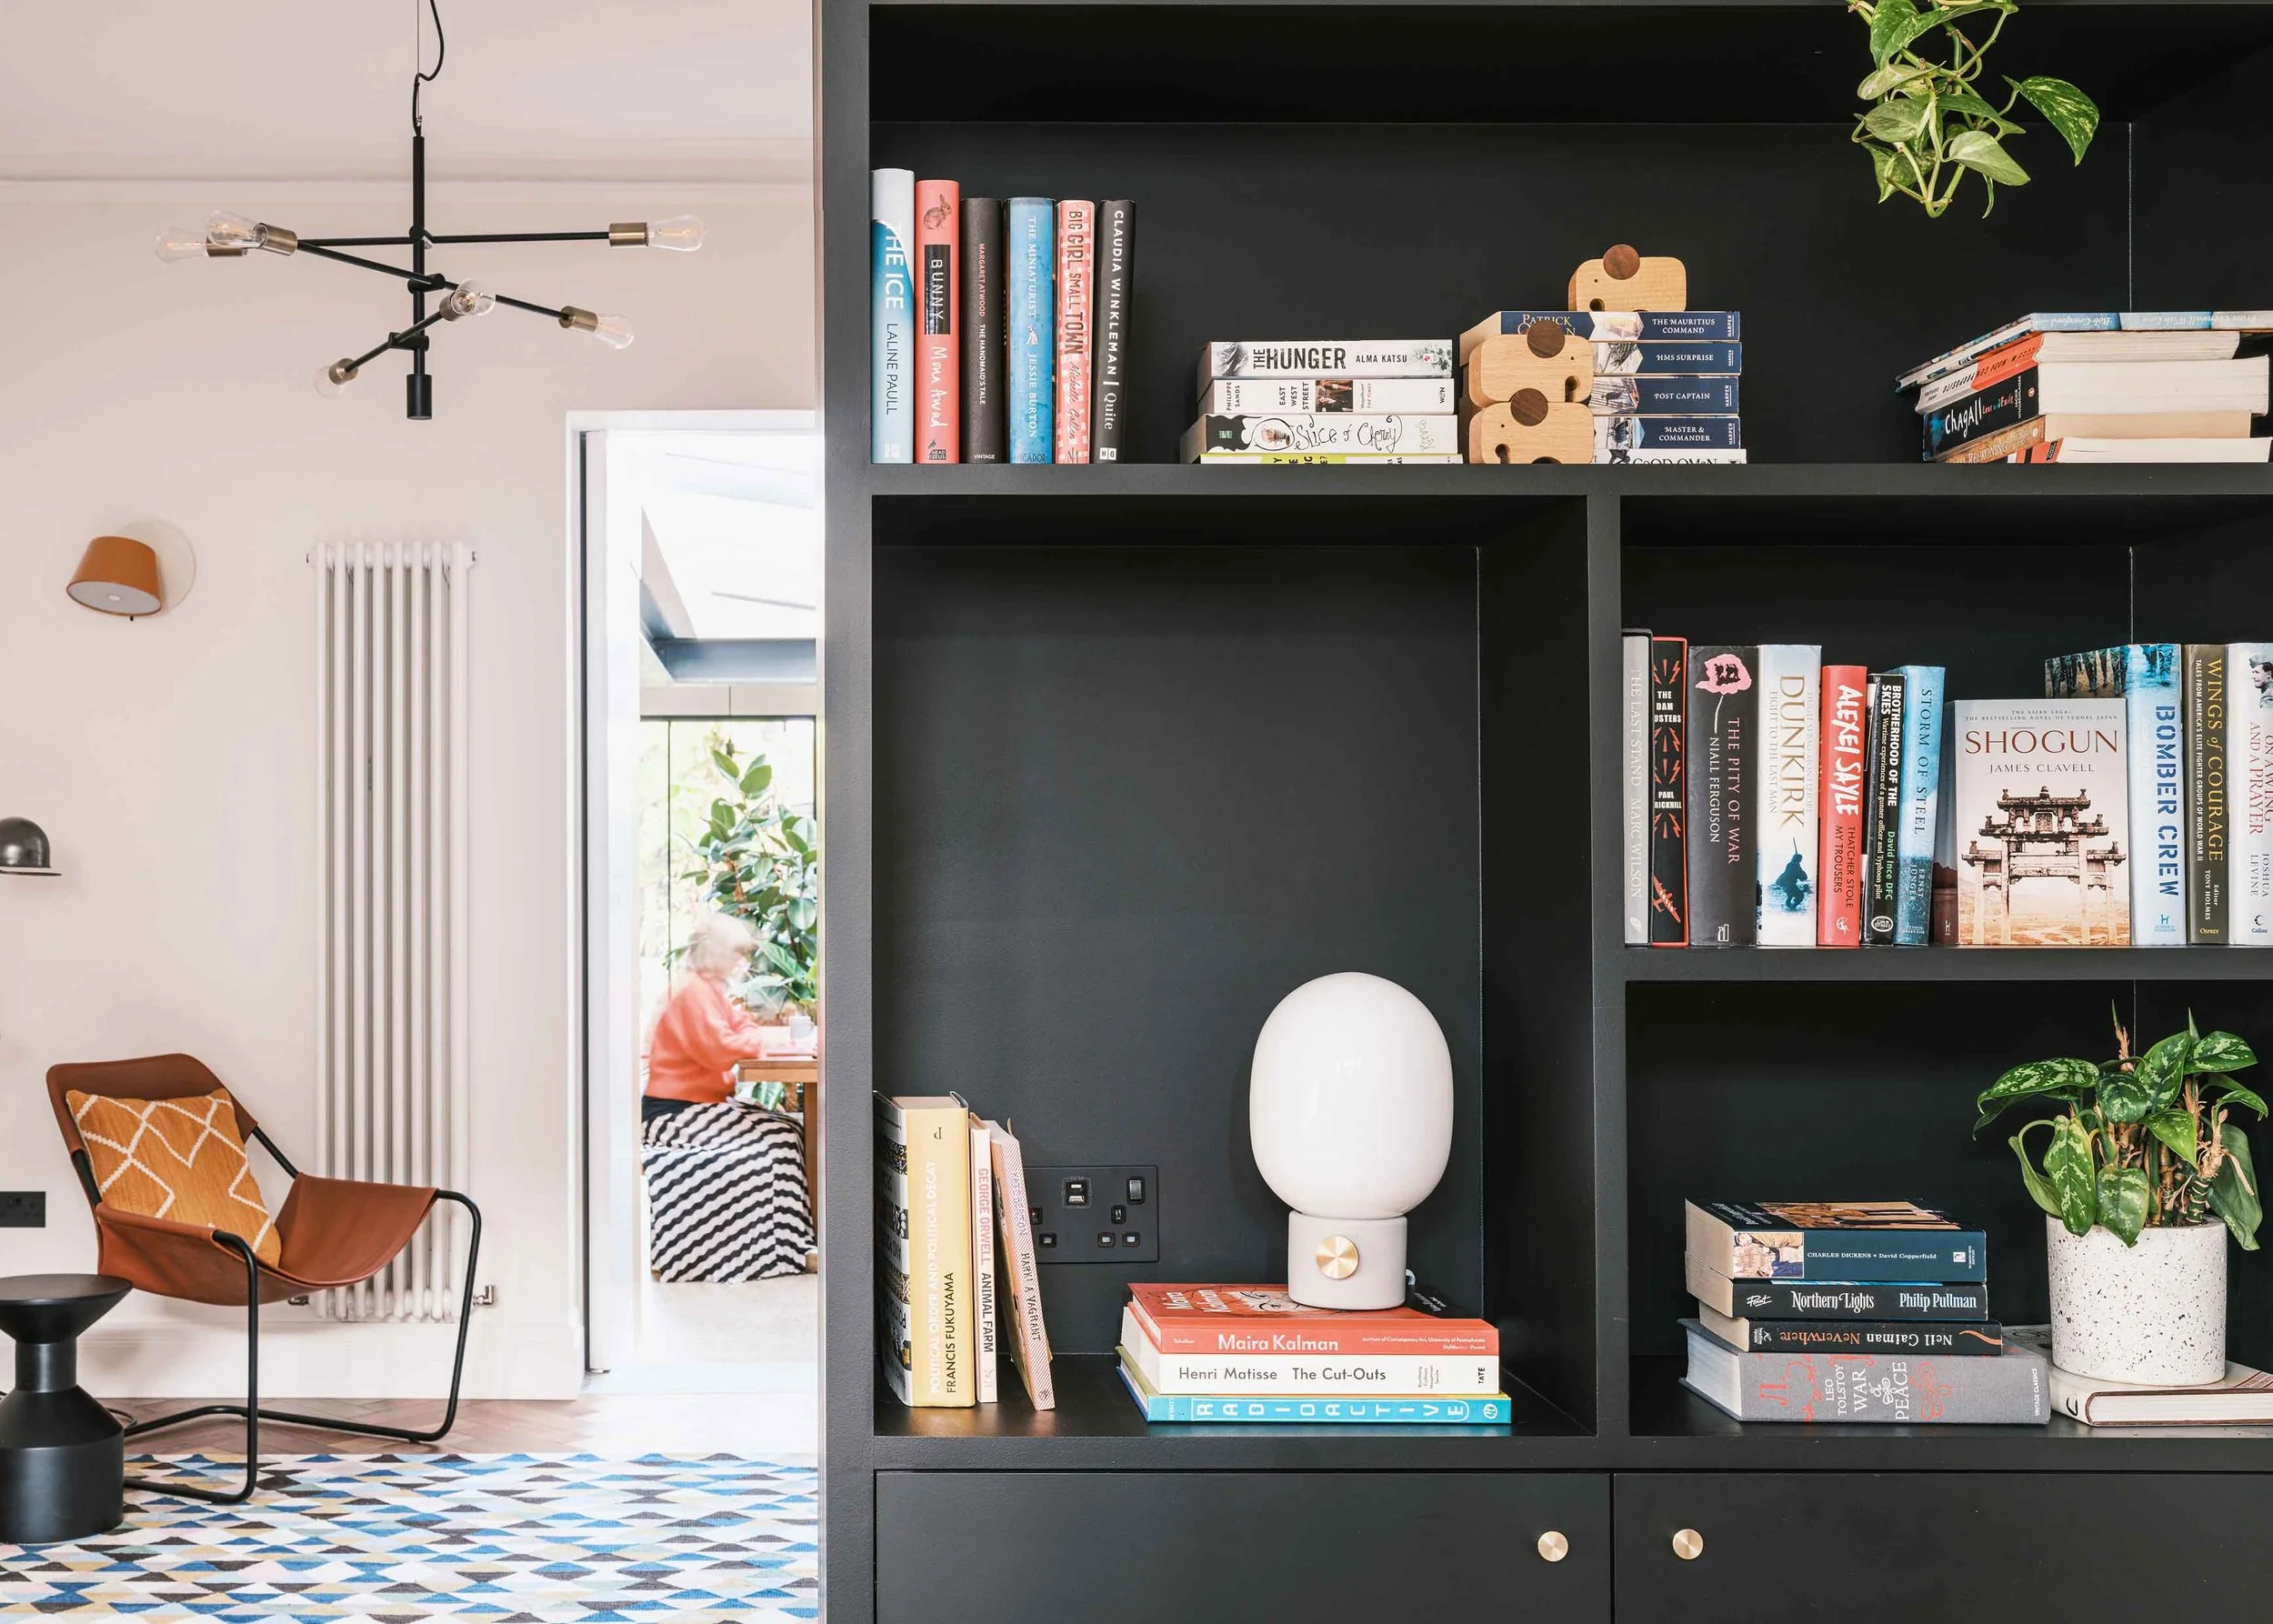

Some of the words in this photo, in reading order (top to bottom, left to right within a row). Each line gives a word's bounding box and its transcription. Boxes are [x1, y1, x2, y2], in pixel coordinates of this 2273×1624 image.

[1028, 216, 1036, 240] THE
[1068, 210, 1083, 232] BIG
[1067, 235, 1084, 269] GIRL
[1111, 210, 1124, 272] CLAUDIA
[886, 274, 904, 309] ICE
[931, 259, 943, 320] BUNNY
[1028, 244, 1037, 316] MINIATURIST
[1068, 273, 1081, 309] SMALL
[1065, 312, 1084, 355] TOWN
[1107, 278, 1122, 375] WINKLEMAN
[887, 324, 898, 370] LALINE
[930, 346, 948, 384] Mona
[1254, 348, 1266, 369] THE
[1267, 347, 1346, 369] HUNGER
[1356, 355, 1377, 363] ALMA
[1382, 355, 1407, 363] KATSU
[1027, 353, 1036, 387] JESSIE
[886, 375, 897, 415] PAULL
[930, 390, 948, 427] Awad
[1105, 393, 1116, 430] Quite
[1029, 393, 1037, 437] BURTON
[1657, 691, 1672, 699] THE
[1769, 691, 1778, 724] FIGHT
[1881, 685, 1891, 715] SKIES
[2208, 658, 2222, 730] WINGS
[1631, 702, 1642, 737] LAST
[1655, 715, 1681, 723] USTERS
[1728, 717, 1740, 750] THE
[1768, 727, 1777, 739] TO
[1830, 685, 1863, 755] ALEXEI
[1889, 686, 1901, 767] BROTHERHOOD
[1919, 688, 1932, 746] STORM
[1769, 743, 1777, 759] THE
[1779, 676, 1805, 827] DUNKIRK
[2207, 737, 2222, 751] of
[2250, 723, 2261, 750] AND
[1631, 739, 1642, 787] STAND
[1710, 737, 1719, 773] NIALL
[1918, 757, 1928, 777] OF
[1988, 764, 2030, 774] JAMES
[2037, 764, 2094, 772] CLAVELL
[2156, 706, 2178, 814] BOMBER
[2249, 755, 2260, 763] A
[1728, 758, 1740, 794] PITY
[1768, 766, 1777, 787] LAST
[1829, 757, 1861, 816] SAYLE
[1888, 770, 1898, 784] OF
[1655, 801, 1681, 809] RICKHILL
[1710, 777, 1720, 842] FERGUSON
[1728, 799, 1740, 821] OF
[1768, 789, 1777, 813] MAN
[1887, 787, 1898, 807] THE
[1915, 787, 1928, 835] STEEL
[2197, 807, 2203, 815] OF
[2208, 756, 2223, 861] COURAGE
[2249, 768, 2263, 835] PRAYER
[1631, 798, 1642, 838] MARC
[1835, 826, 1843, 840] MY
[1728, 827, 1740, 864] WAR
[1846, 826, 1856, 875] THATCHER
[2158, 825, 2178, 896] CREW
[1631, 844, 1642, 897] WILSON
[1834, 844, 1843, 893] TROUSERS
[1886, 859, 1895, 879] Ince
[2250, 855, 2258, 897] LEVINE
[1846, 878, 1854, 908] STOLE
[926, 1161, 936, 1198] DECAY
[978, 1168, 989, 1215] GEORGE
[927, 1197, 937, 1261] POLITICAL
[979, 1218, 991, 1266] ORWELL
[928, 1262, 938, 1289] AND
[944, 1272, 956, 1339] FUKUYAMA
[981, 1272, 993, 1318] ANIMAL
[1790, 1290, 1838, 1313] Northern
[1838, 1292, 1875, 1314] Lights
[1898, 1293, 1930, 1312] Philip
[1932, 1293, 1977, 1308] Pullman
[928, 1293, 939, 1334] ORDER
[982, 1320, 993, 1353] FARM
[1218, 1334, 1268, 1350] Maira
[1273, 1335, 1338, 1350] Kalman
[1779, 1331, 1860, 1346] Neverwhere
[1866, 1333, 1919, 1347] Gaiman
[1925, 1334, 1953, 1346] Neil
[929, 1338, 940, 1393] POLITICAL
[945, 1343, 956, 1393] FRANCIS
[1179, 1367, 1217, 1379] Henri
[1224, 1368, 1277, 1380] Matisse
[1292, 1368, 1317, 1380] The
[1322, 1368, 1387, 1380] Cut-Outs
[1477, 1367, 1486, 1384] TATE
[1825, 1378, 1835, 1401] LEO
[1835, 1364, 1847, 1417] TOLSTOY
[1852, 1368, 1868, 1413] WAR
[1893, 1361, 1909, 1421] PEACE
[1197, 1403, 1464, 1417] RADIOACTIVE
